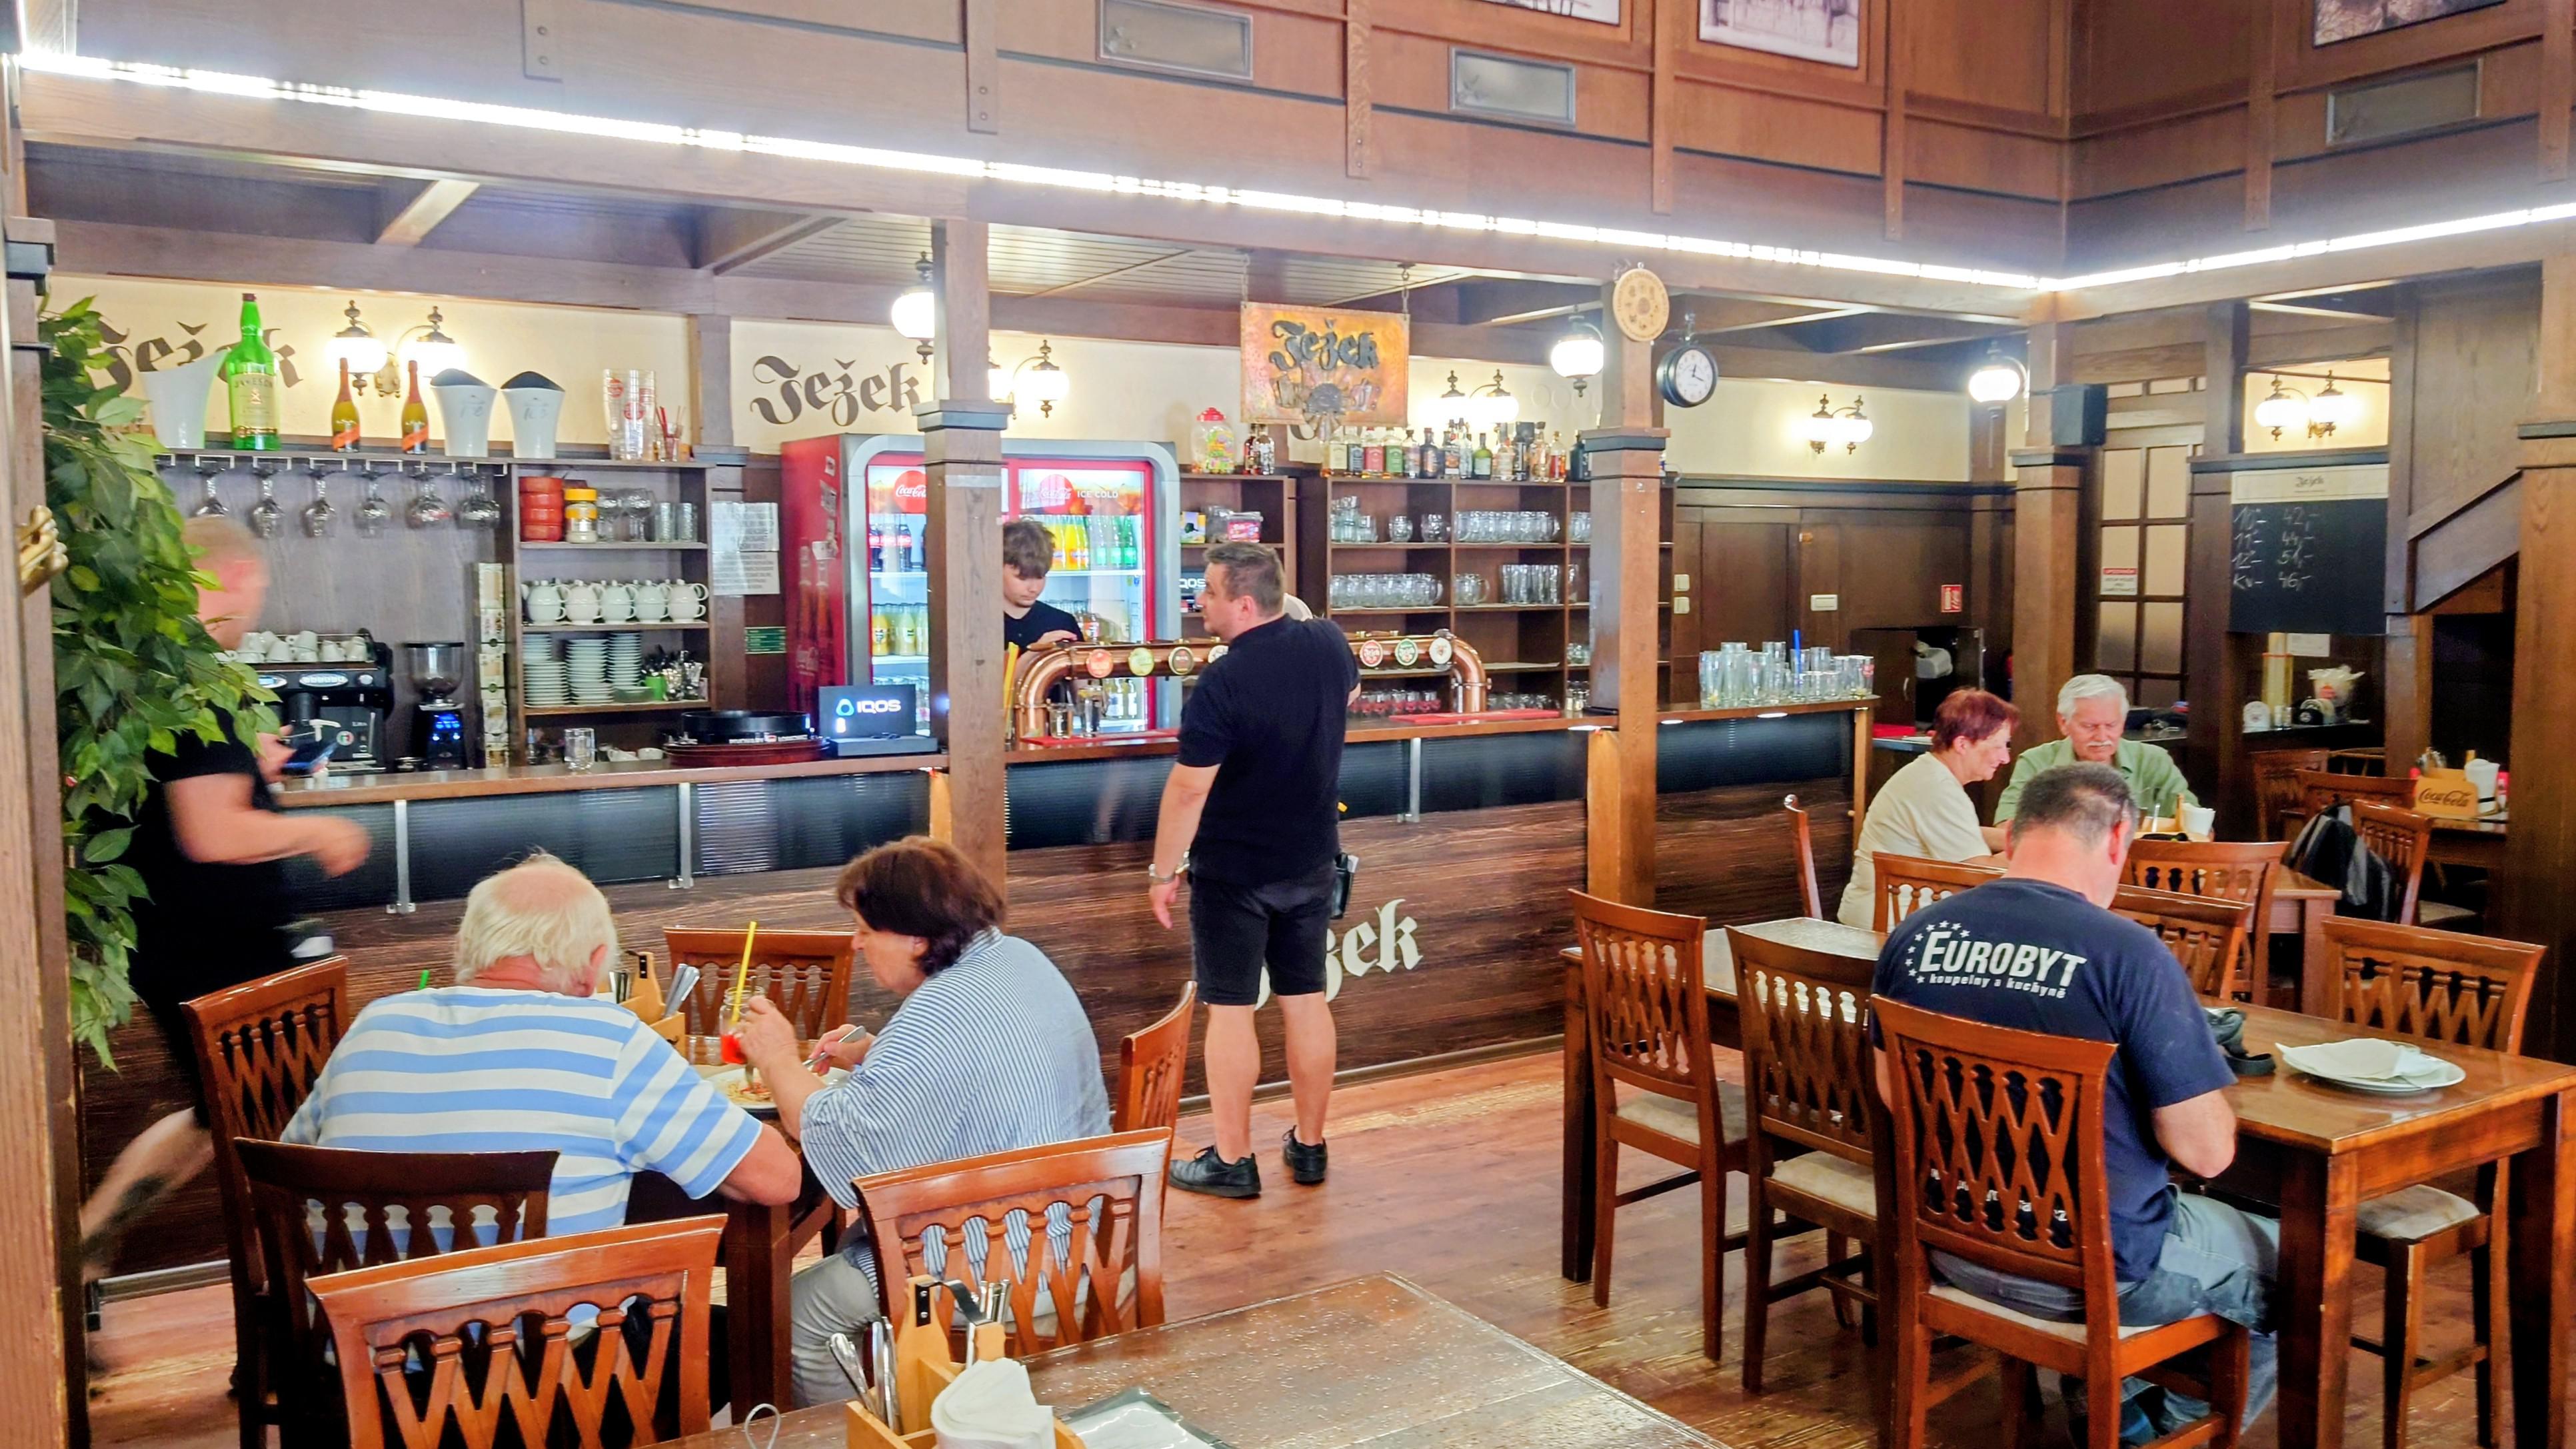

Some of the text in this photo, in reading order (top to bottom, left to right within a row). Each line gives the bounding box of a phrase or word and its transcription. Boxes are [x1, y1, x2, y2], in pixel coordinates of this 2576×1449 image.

[1269, 318, 1379, 371] Ježek
[750, 355, 920, 427] Ježek
[1094, 490, 1118, 499] COLD
[856, 699, 902, 715] IQOS
[1930, 974, 2067, 998] koupelny a kuchyně
